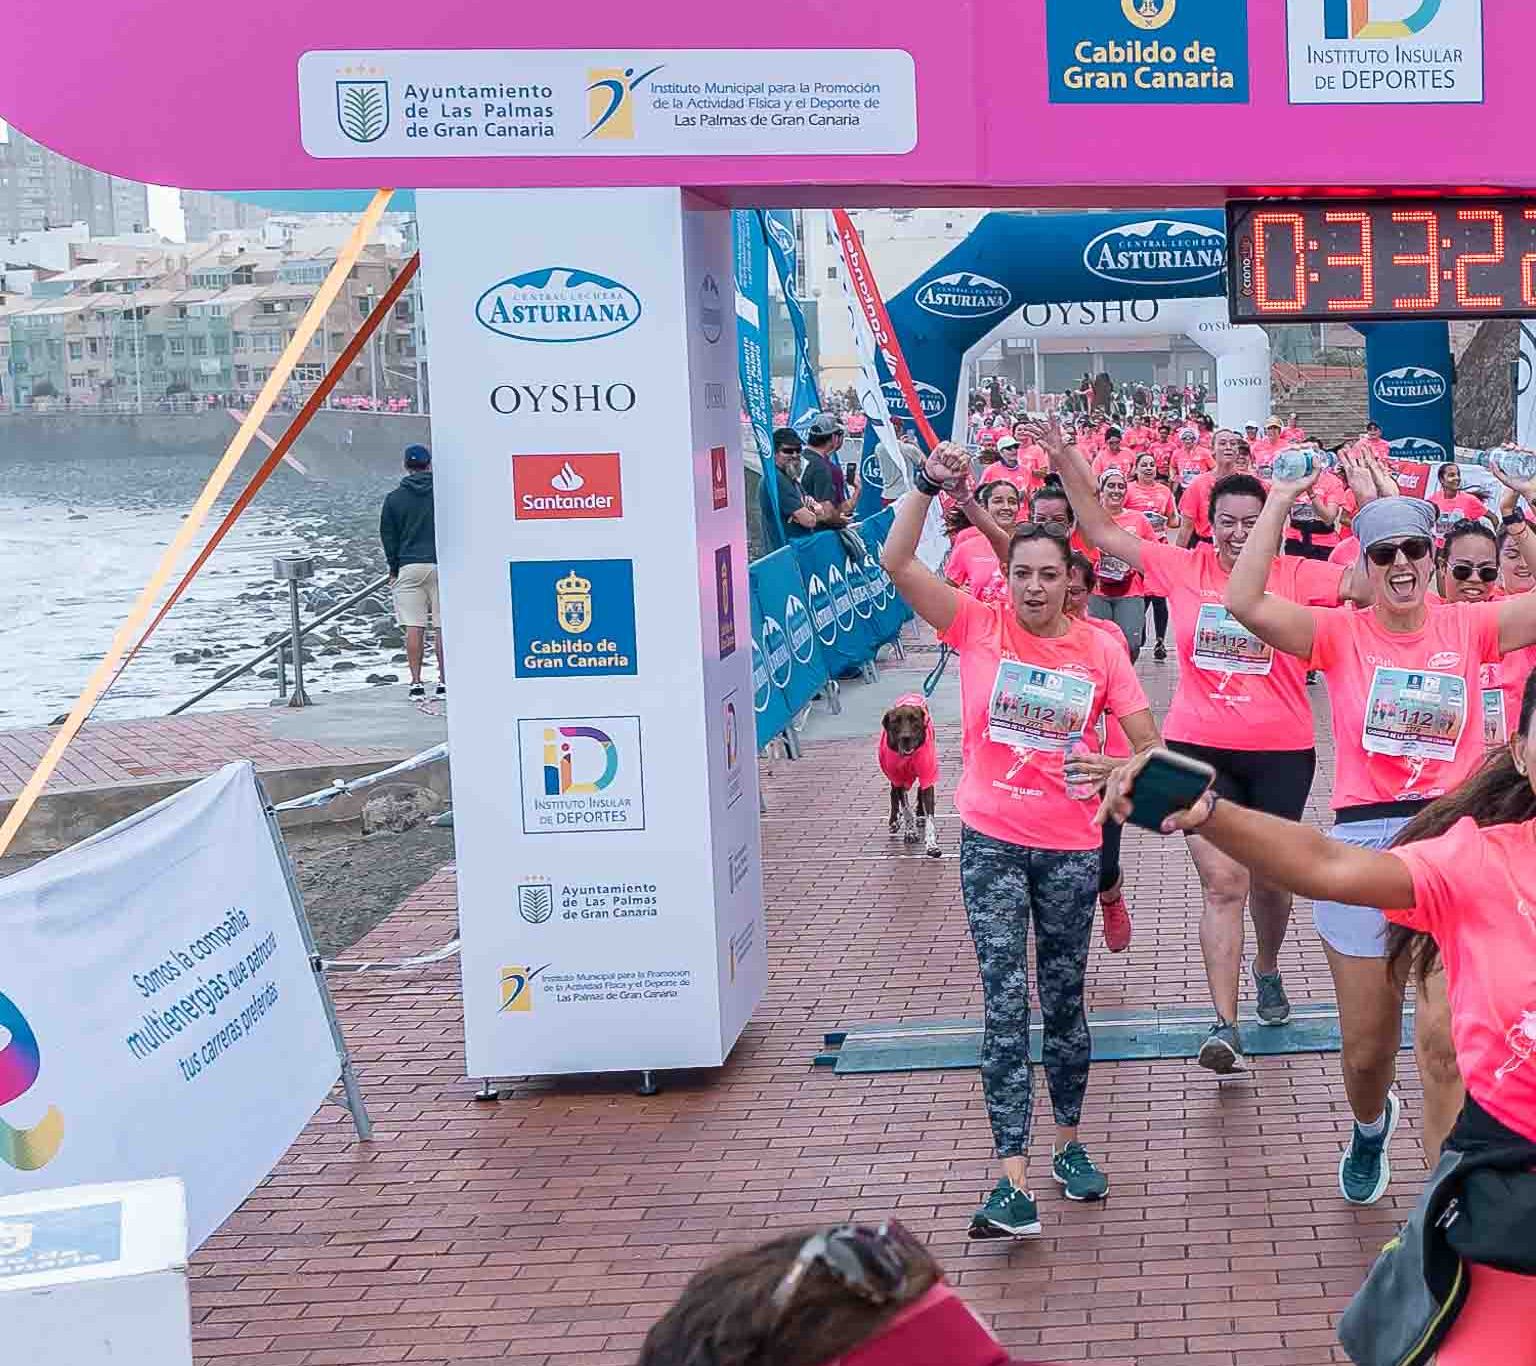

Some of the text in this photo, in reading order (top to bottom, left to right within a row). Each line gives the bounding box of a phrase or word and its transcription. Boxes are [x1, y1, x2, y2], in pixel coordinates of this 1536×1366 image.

[1074, 41, 1216, 65] Cabildo de
[1307, 44, 1462, 64] INSTITUTO INSULAR
[1063, 66, 1234, 89] Gran Canaria
[1315, 70, 1455, 90] DE DEPORTES
[404, 83, 553, 103] Ayuntamiento
[651, 81, 880, 97] Instituto Municipal para la Promoción
[405, 103, 554, 119] de Las Palmas
[653, 98, 667, 109] de
[673, 98, 683, 109] la
[688, 98, 743, 109] Actividad
[784, 101, 791, 112] y
[794, 98, 806, 109] el
[811, 98, 860, 112] Deporte
[864, 97, 879, 108] de
[674, 113, 859, 127] Las Palmas de Gran Canaria
[406, 122, 555, 139] de Gran Canaria
[1096, 242, 1227, 270] ASTURIANA
[921, 288, 1005, 308] ASTURIANA
[488, 297, 630, 324] ASTURIANA
[1022, 298, 1159, 327] OYSHO
[1378, 382, 1441, 396] ASTURIANA
[490, 384, 637, 414] OYSHO
[522, 494, 614, 511] Santander
[531, 639, 617, 655] Cabildo de
[524, 653, 629, 670] Gran Canaria
[1021, 703, 1056, 722] 112
[1399, 709, 1433, 726] 112
[556, 810, 627, 825] DEPORTES
[562, 883, 657, 898] Ayuntamiento
[562, 894, 657, 907] de Las Palmas
[562, 906, 657, 919] de Gran Canaria
[133, 961, 182, 998] Somos
[169, 950, 194, 972] la
[127, 960, 249, 1060] multienergías que
[180, 1018, 244, 1082] tus carreras
